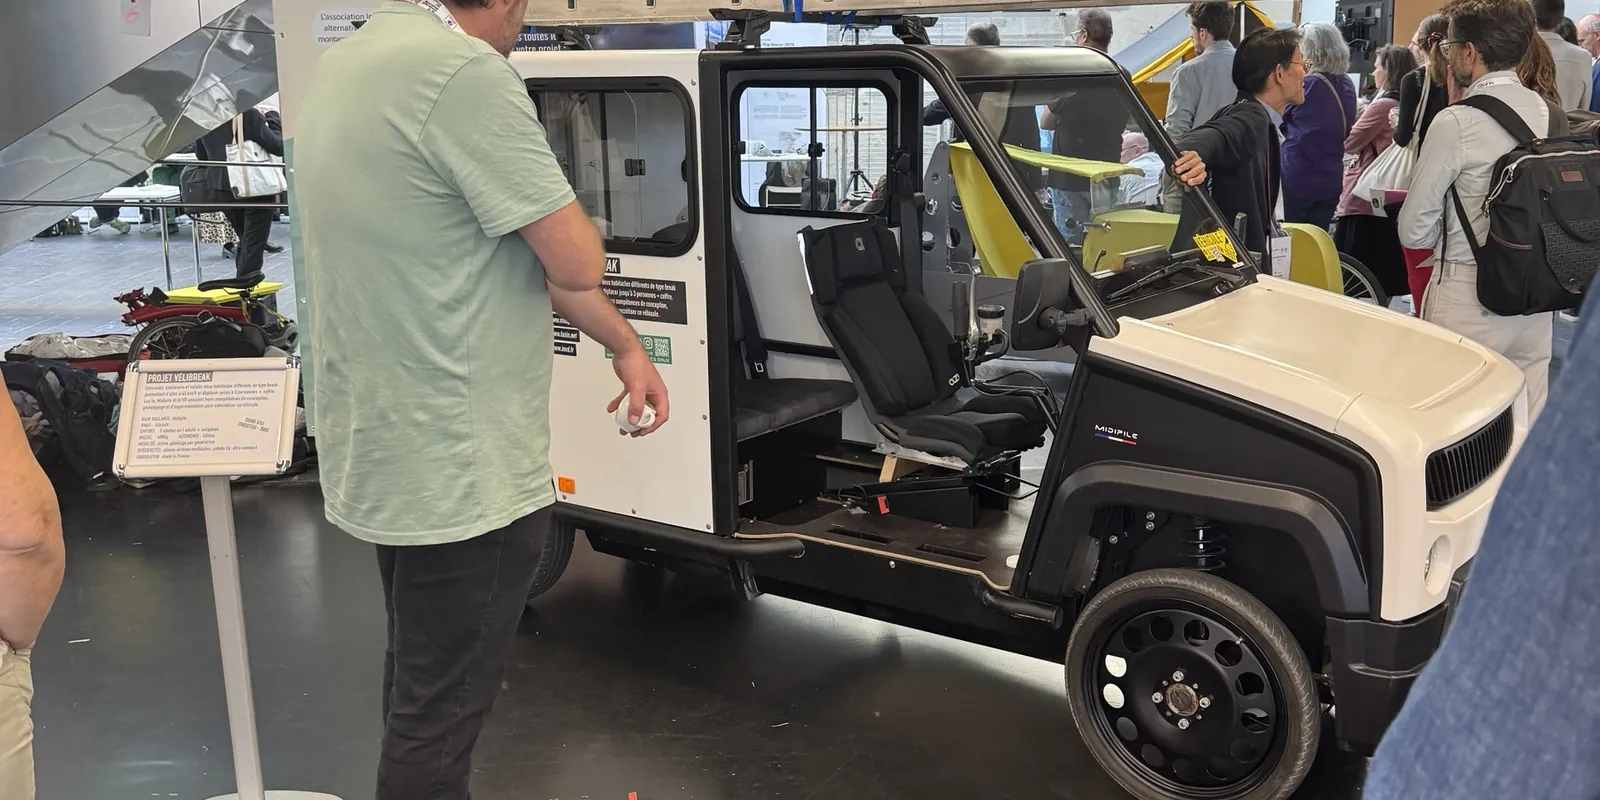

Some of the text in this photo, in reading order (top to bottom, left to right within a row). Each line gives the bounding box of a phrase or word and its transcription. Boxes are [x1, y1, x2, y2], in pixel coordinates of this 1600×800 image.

[524, 33, 548, 41] toutes
[604, 259, 618, 272] AK
[148, 372, 211, 382] PROJET VÉLIBREAK
[1095, 424, 1138, 440] MIDIPILE
